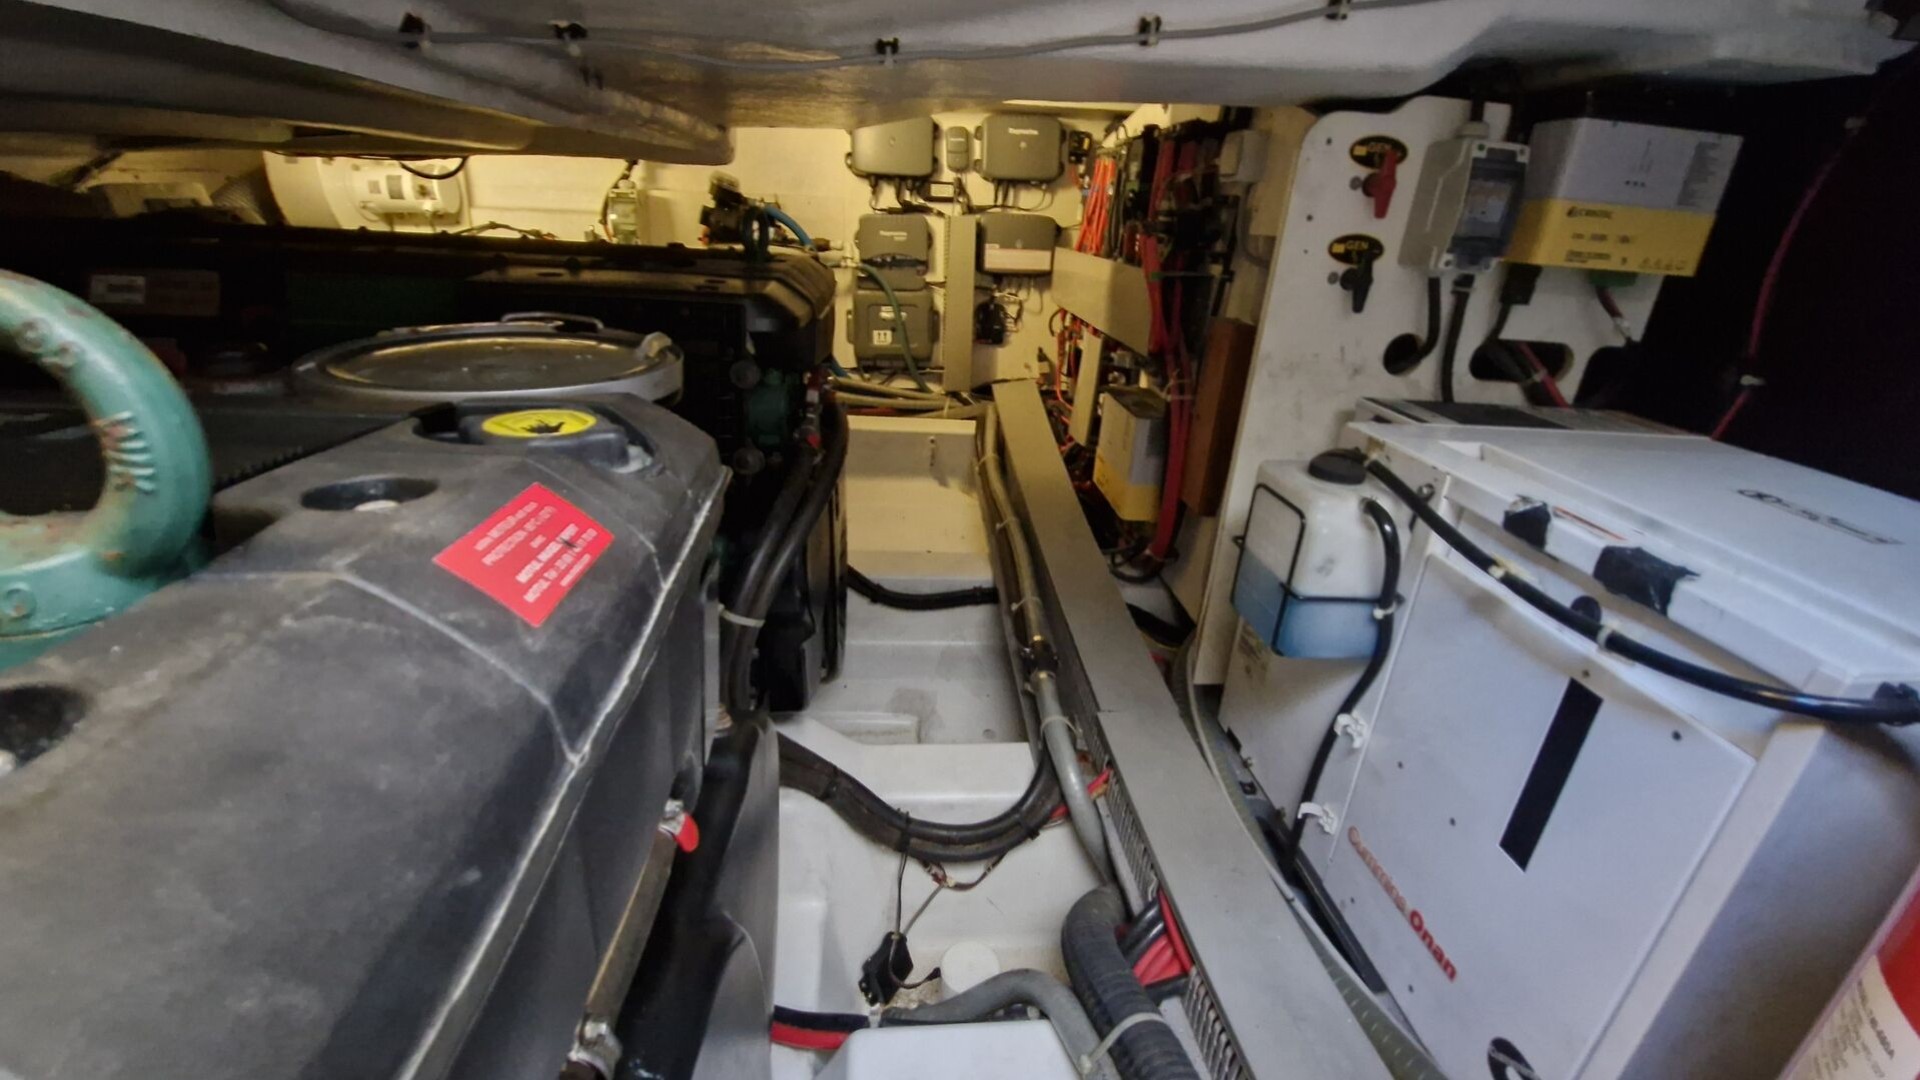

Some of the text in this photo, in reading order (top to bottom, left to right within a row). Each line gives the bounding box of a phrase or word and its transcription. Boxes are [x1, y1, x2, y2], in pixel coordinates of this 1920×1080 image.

[1345, 240, 1369, 252] GEN
[1348, 826, 1457, 981] Cummins Onan
